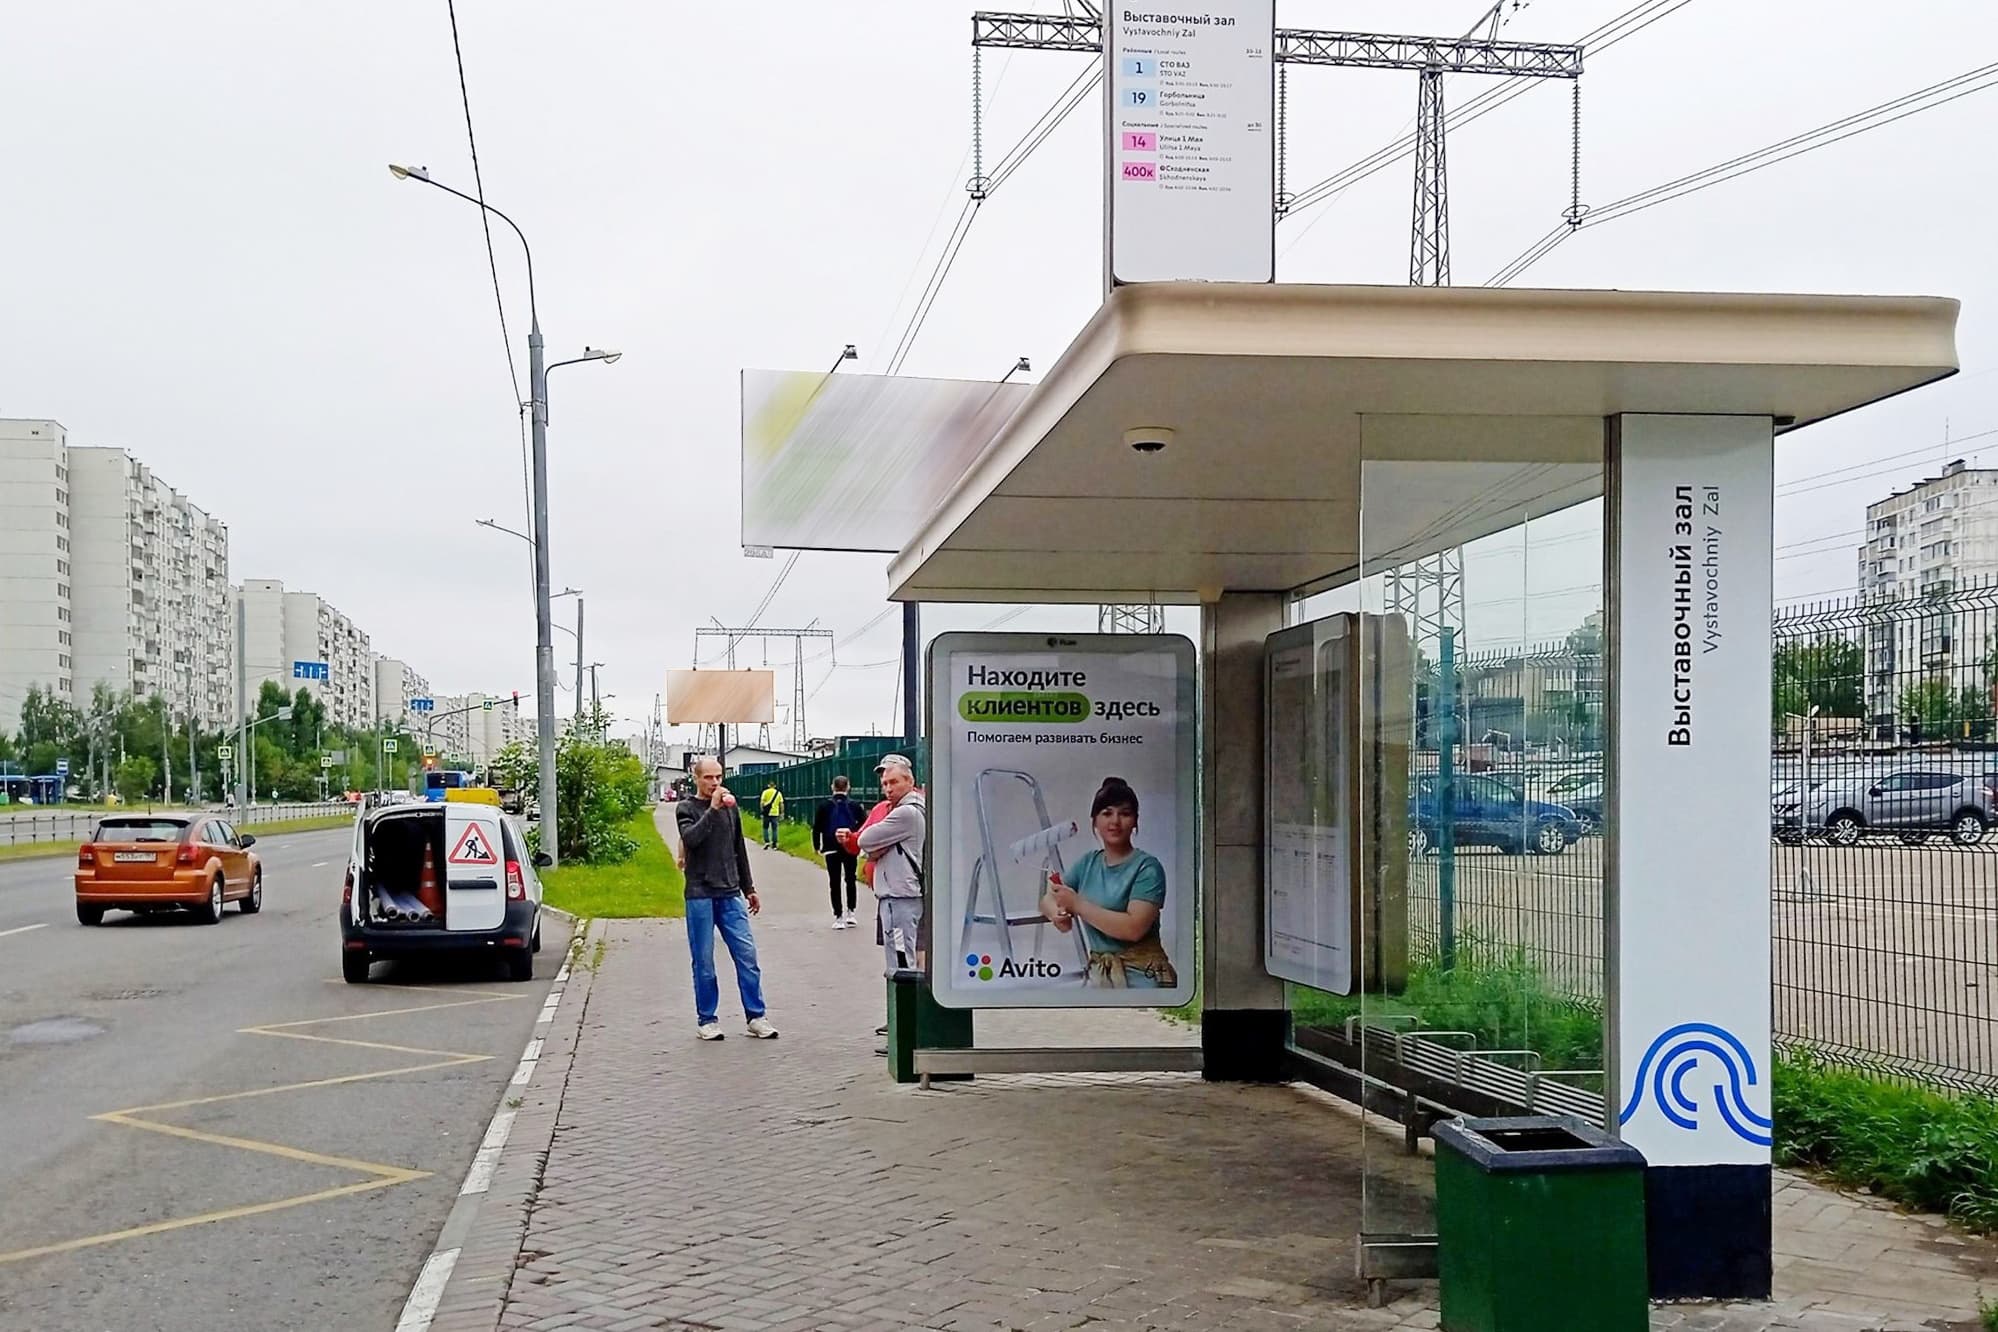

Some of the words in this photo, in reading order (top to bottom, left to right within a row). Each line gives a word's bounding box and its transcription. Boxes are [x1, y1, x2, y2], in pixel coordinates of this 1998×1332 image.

[1123, 11, 1211, 26] Выставочный
[1214, 15, 1235, 26] зал
[1123, 27, 1180, 38] Vystavochniy
[1182, 29, 1196, 38] Zal
[1135, 62, 1143, 74] 1
[1160, 61, 1175, 69] СТО
[1160, 70, 1172, 78] STO
[1132, 92, 1146, 104] 19
[1132, 136, 1146, 148] 14
[1703, 486, 1719, 515] Zal
[1674, 486, 1692, 535] зал
[1702, 526, 1722, 654] Vystavochniy
[1668, 545, 1692, 746] Выставочный
[967, 665, 1086, 690] Находите
[967, 698, 1082, 717] клиентов
[1094, 700, 1160, 720] здесь
[967, 731, 1032, 745] Помогаем
[1035, 733, 1097, 747] развивать
[1100, 732, 1143, 745] бизнес
[999, 957, 1061, 979] Avito
